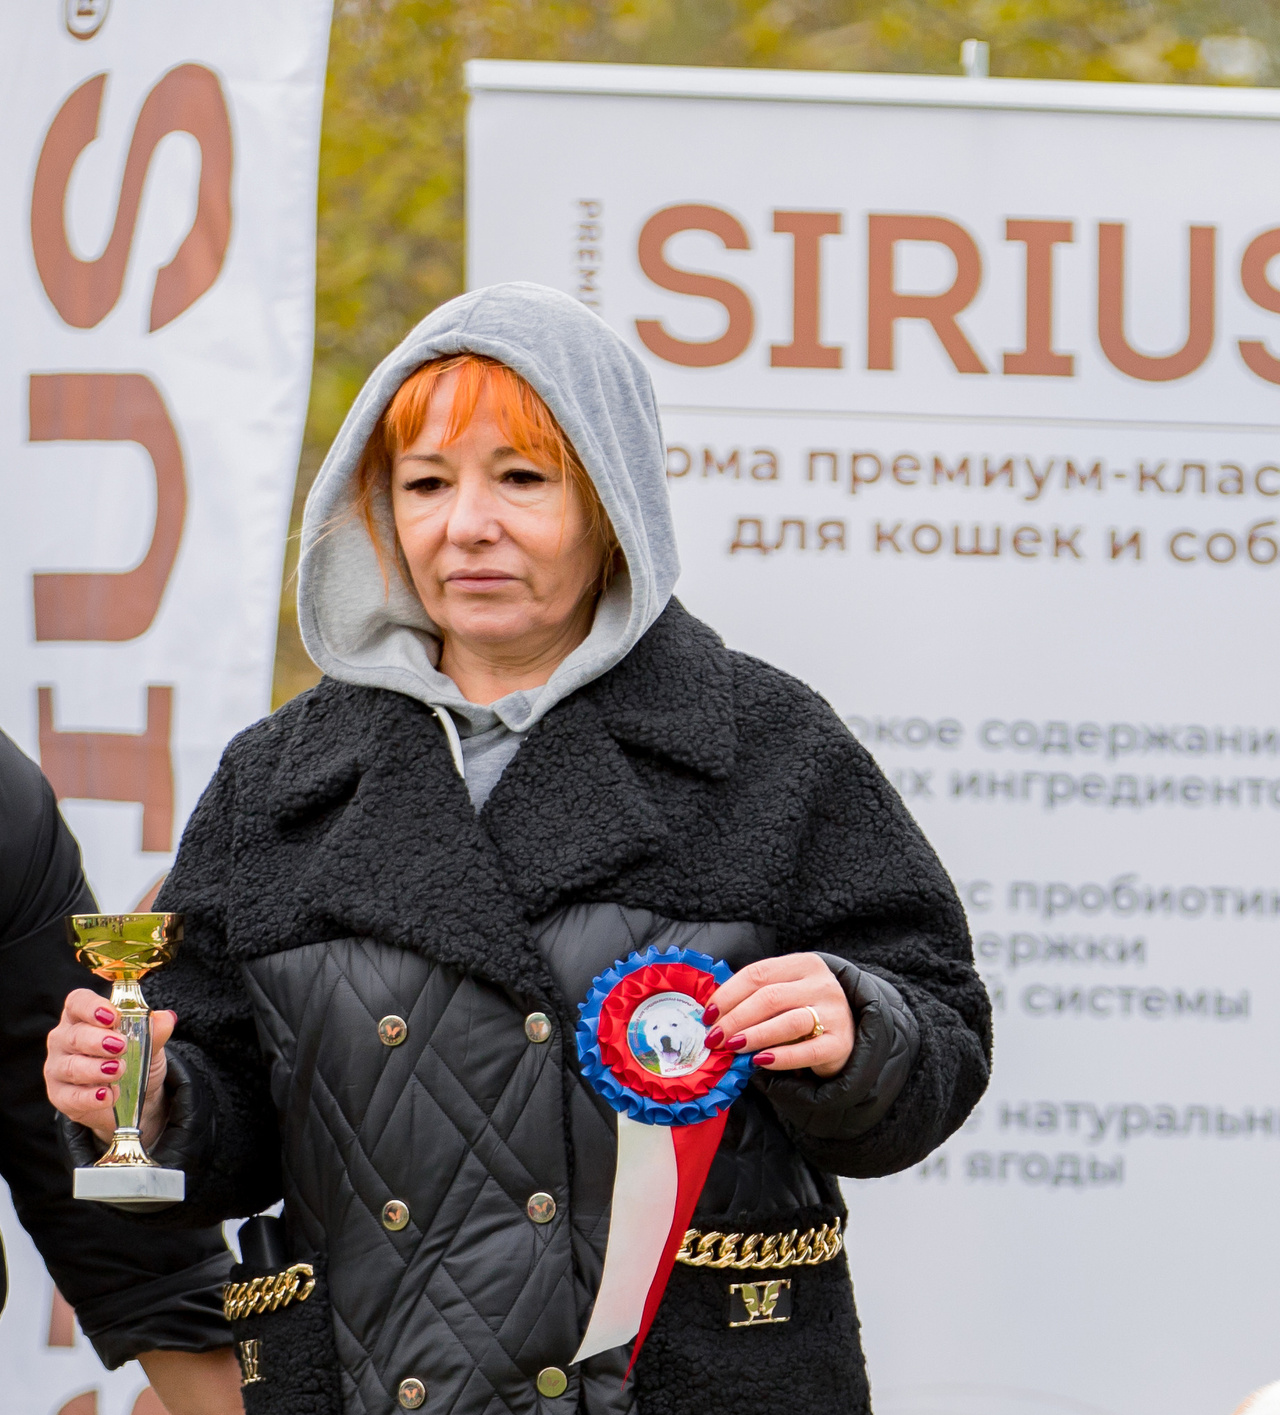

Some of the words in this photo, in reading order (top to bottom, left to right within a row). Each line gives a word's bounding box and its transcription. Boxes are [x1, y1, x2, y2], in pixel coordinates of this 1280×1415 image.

[729, 517, 848, 557] для
[873, 521, 1081, 560] кошек
[1107, 527, 1143, 561] и
[1024, 983, 1250, 1020] системы
[967, 1152, 1123, 1188] ягоды
